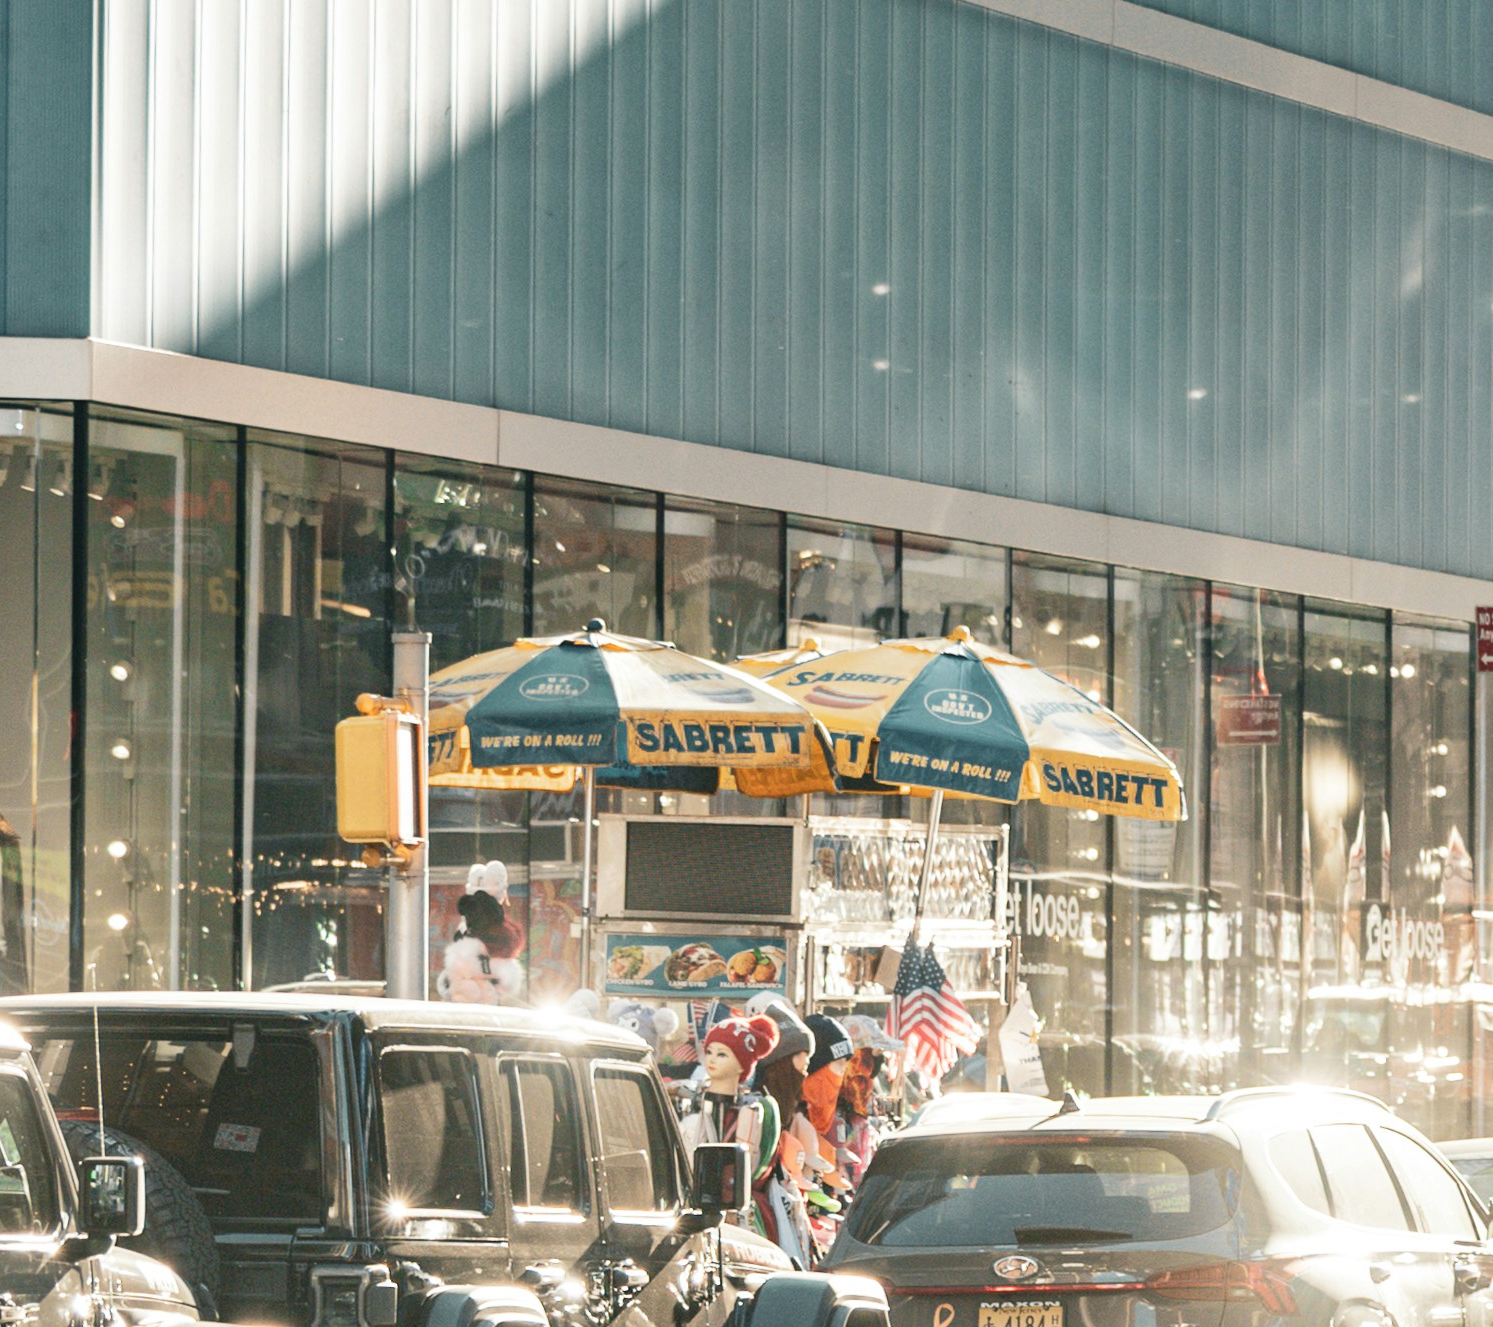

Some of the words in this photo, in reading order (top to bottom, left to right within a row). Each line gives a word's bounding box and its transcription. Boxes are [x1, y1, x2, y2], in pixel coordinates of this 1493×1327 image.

[1479, 613, 1491, 626] NO
[787, 671, 907, 687] SABRETT
[481, 735, 521, 749] WE'RE
[523, 734, 542, 747] ON
[544, 734, 553, 746] A
[555, 734, 584, 747] ROLL
[635, 721, 806, 755] SABRETT
[890, 750, 929, 768] WE'RE
[931, 759, 949, 771] ON
[951, 761, 960, 773] A
[962, 763, 993, 779] ROLL
[1042, 763, 1169, 808] SABRETT
[1006, 881, 1022, 935] et
[980, 1300, 1061, 1309] MAXON
